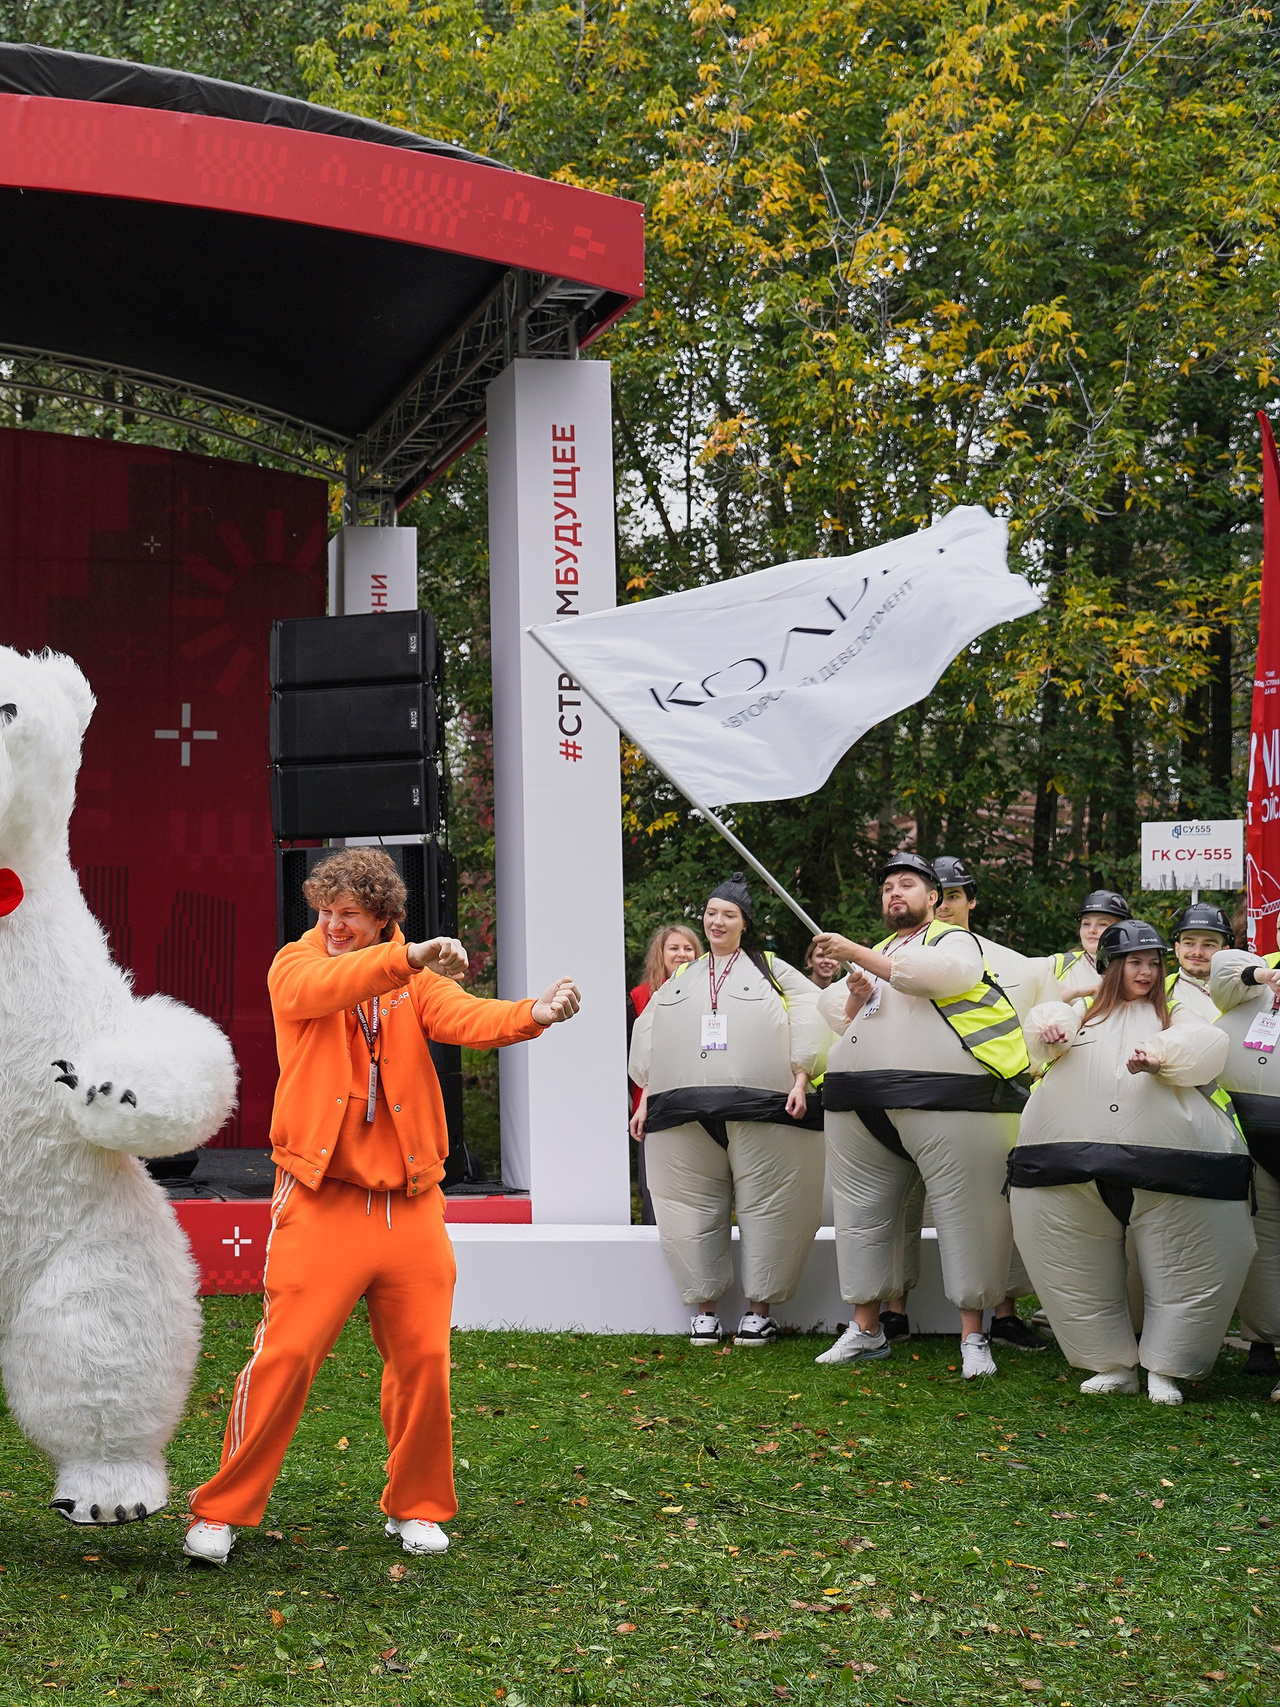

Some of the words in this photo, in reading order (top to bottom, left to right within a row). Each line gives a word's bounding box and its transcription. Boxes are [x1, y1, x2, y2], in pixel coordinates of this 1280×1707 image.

[371, 575, 387, 614] НИ
[552, 424, 583, 762] #СТРМБУДУЩЕЕ
[1152, 849, 1171, 861] ГК
[1175, 848, 1232, 861] СУ-555
